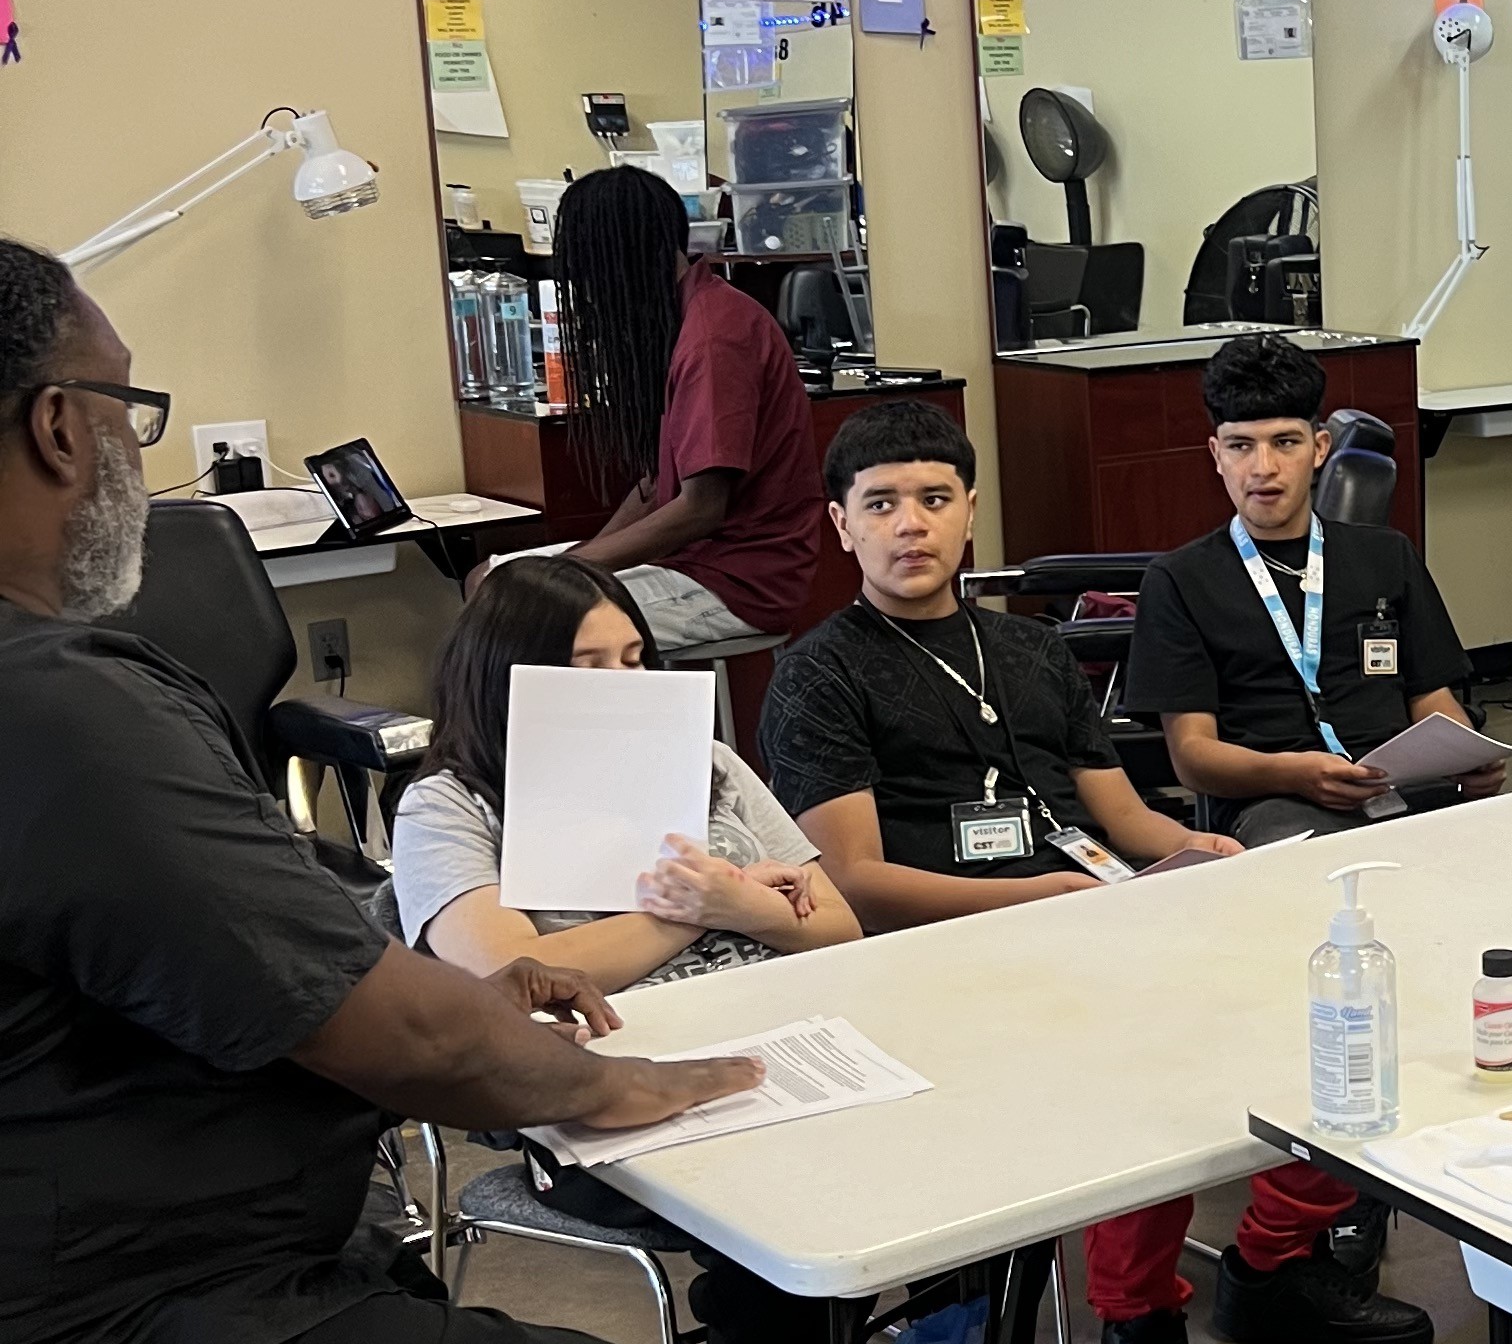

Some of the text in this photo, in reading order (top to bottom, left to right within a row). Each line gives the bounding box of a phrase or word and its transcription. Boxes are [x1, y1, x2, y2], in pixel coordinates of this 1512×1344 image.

[774, 38, 789, 61] 8
[972, 826, 1011, 836] visitor
[973, 841, 994, 851] CST
